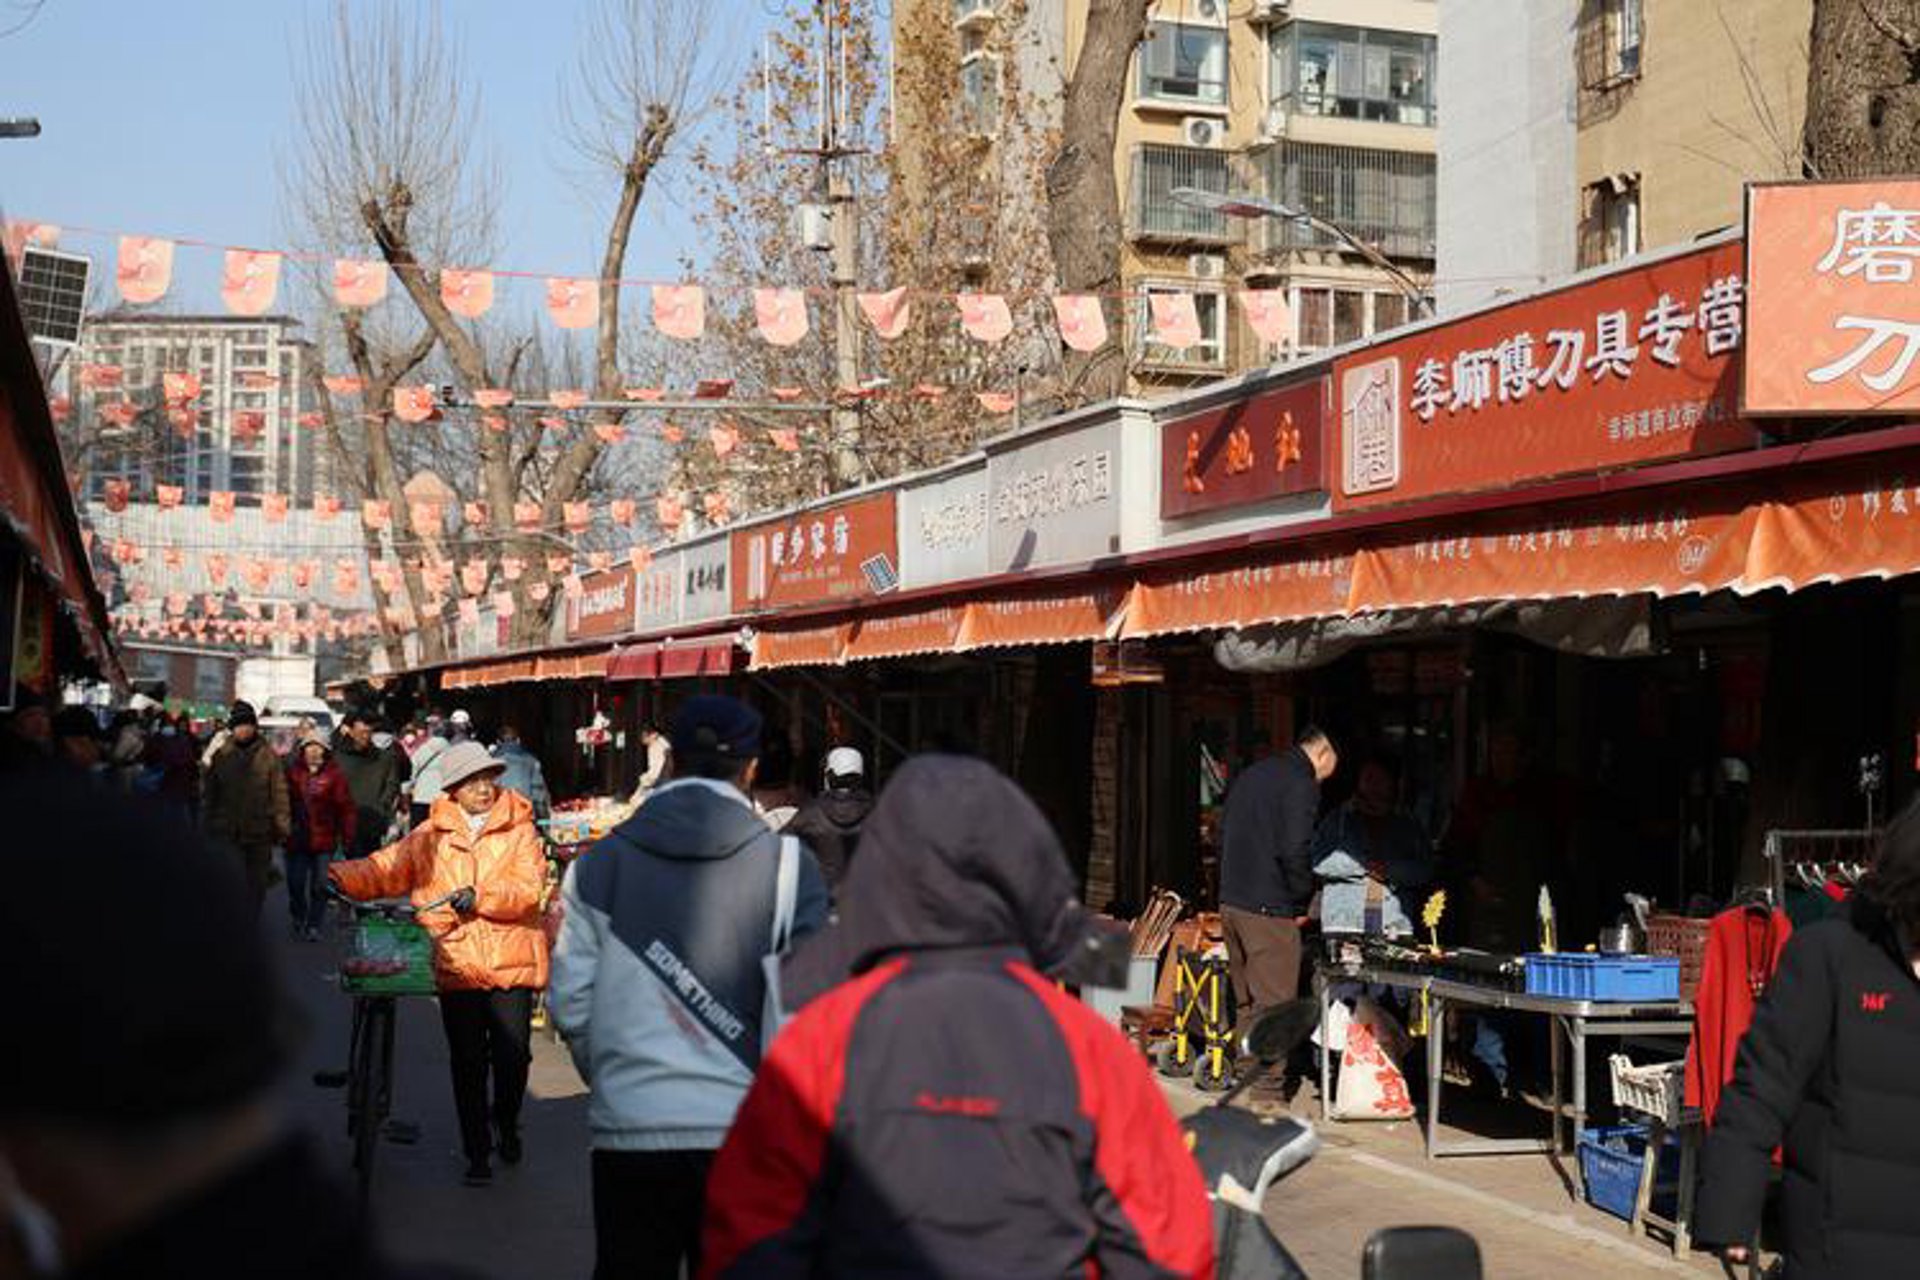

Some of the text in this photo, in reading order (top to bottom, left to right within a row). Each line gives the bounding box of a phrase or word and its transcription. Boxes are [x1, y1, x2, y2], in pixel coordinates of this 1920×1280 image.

[1410, 275, 1743, 421] 李师傅刀具专营
[644, 940, 745, 1041] SOMETHING
